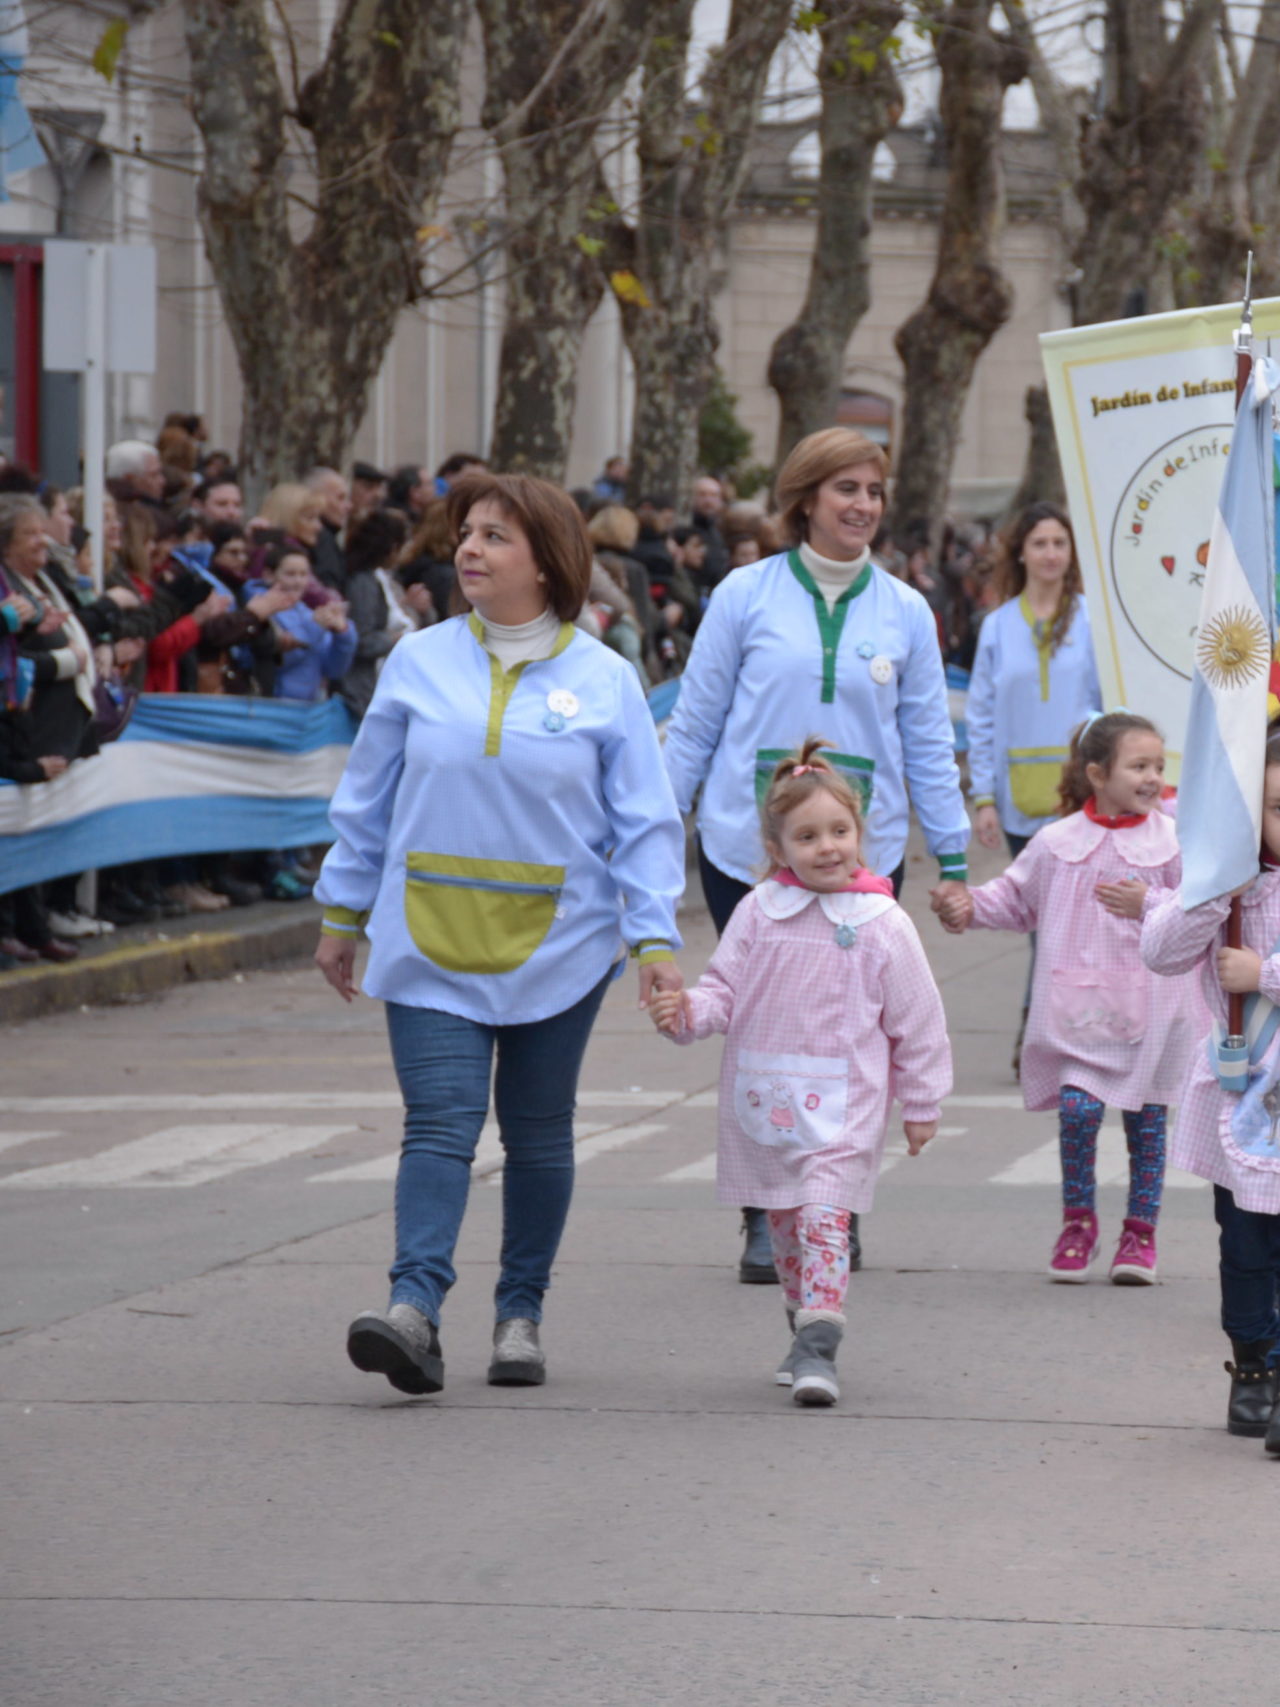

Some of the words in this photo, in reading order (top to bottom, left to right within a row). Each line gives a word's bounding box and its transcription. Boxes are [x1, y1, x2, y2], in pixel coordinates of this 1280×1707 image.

[1090, 387, 1152, 417] Jardín
[1156, 384, 1180, 402] de
[1164, 457, 1188, 477] de
